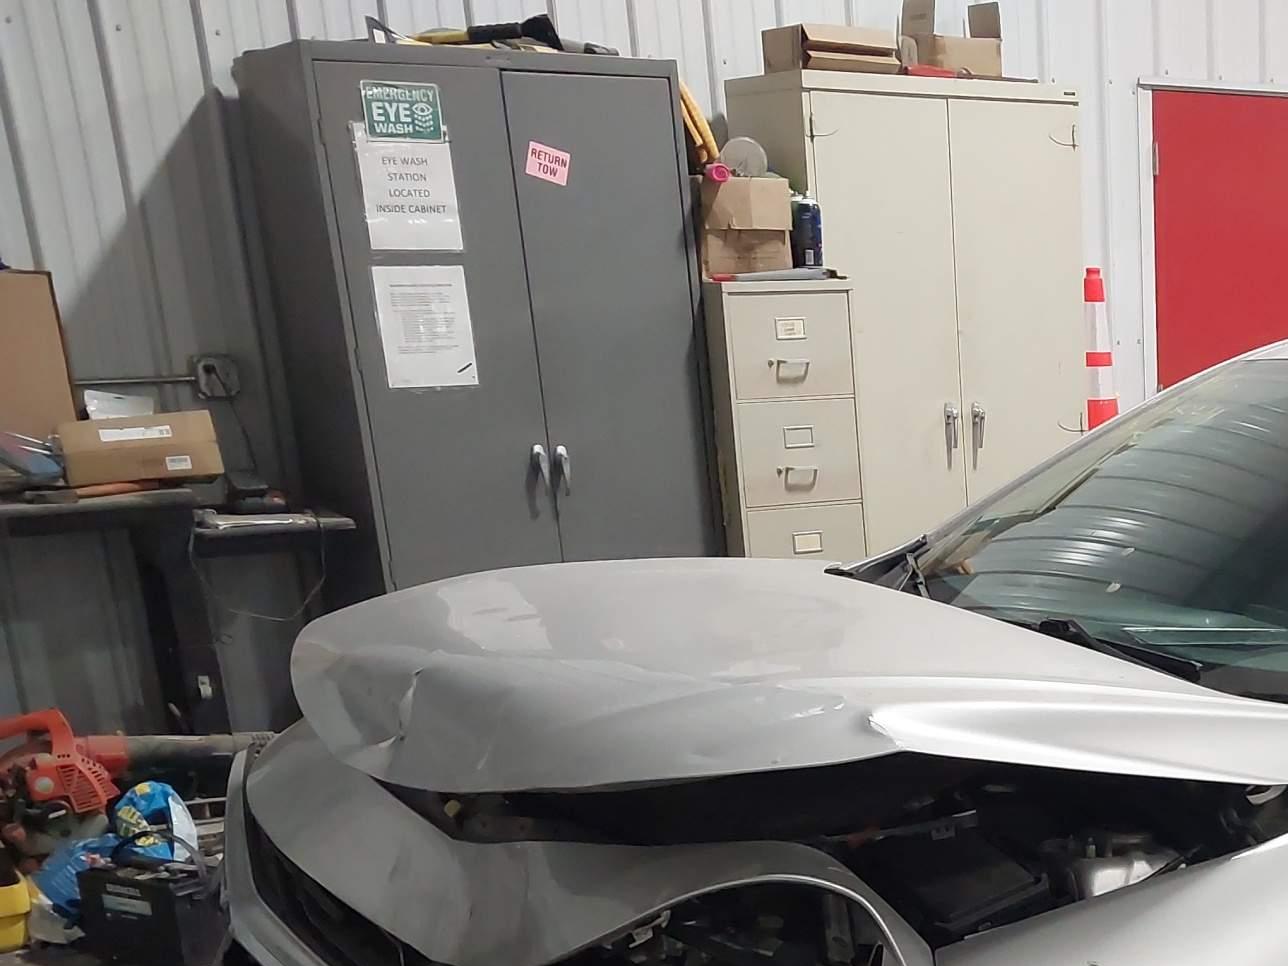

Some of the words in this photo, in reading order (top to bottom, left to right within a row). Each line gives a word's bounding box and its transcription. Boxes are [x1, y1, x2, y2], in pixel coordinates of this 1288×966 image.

[365, 86, 434, 102] EMERGENCY
[371, 102, 413, 122] EYE
[374, 122, 414, 134] WASH
[382, 157, 398, 166] EYE
[401, 157, 428, 166] WASH
[530, 148, 568, 169] RETURN
[537, 161, 559, 177] TOW
[387, 173, 427, 182] STATION
[389, 189, 431, 198] LOCATED
[376, 204, 405, 213] INSIDE
[408, 205, 447, 214] CABINET
